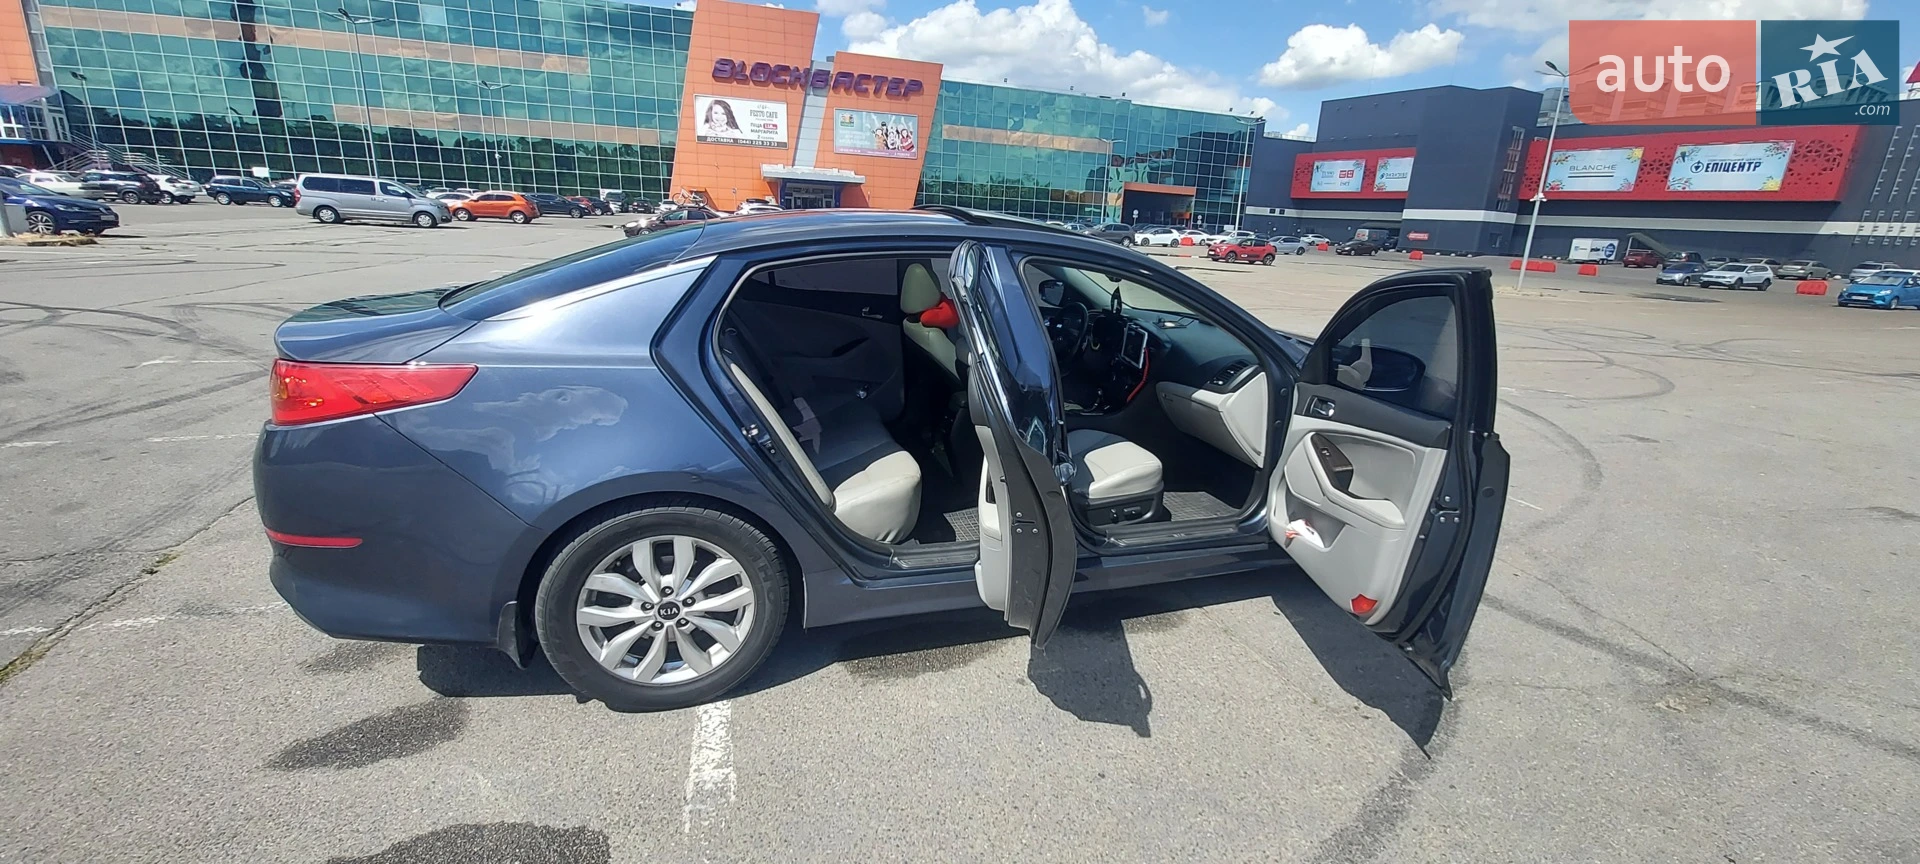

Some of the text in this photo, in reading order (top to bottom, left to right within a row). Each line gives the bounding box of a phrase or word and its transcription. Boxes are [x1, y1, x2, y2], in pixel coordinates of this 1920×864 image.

[1569, 164, 1617, 172] BLANCHE
[1704, 161, 1763, 173] ЕПІЦЕНТР
[660, 607, 679, 616] KIA
